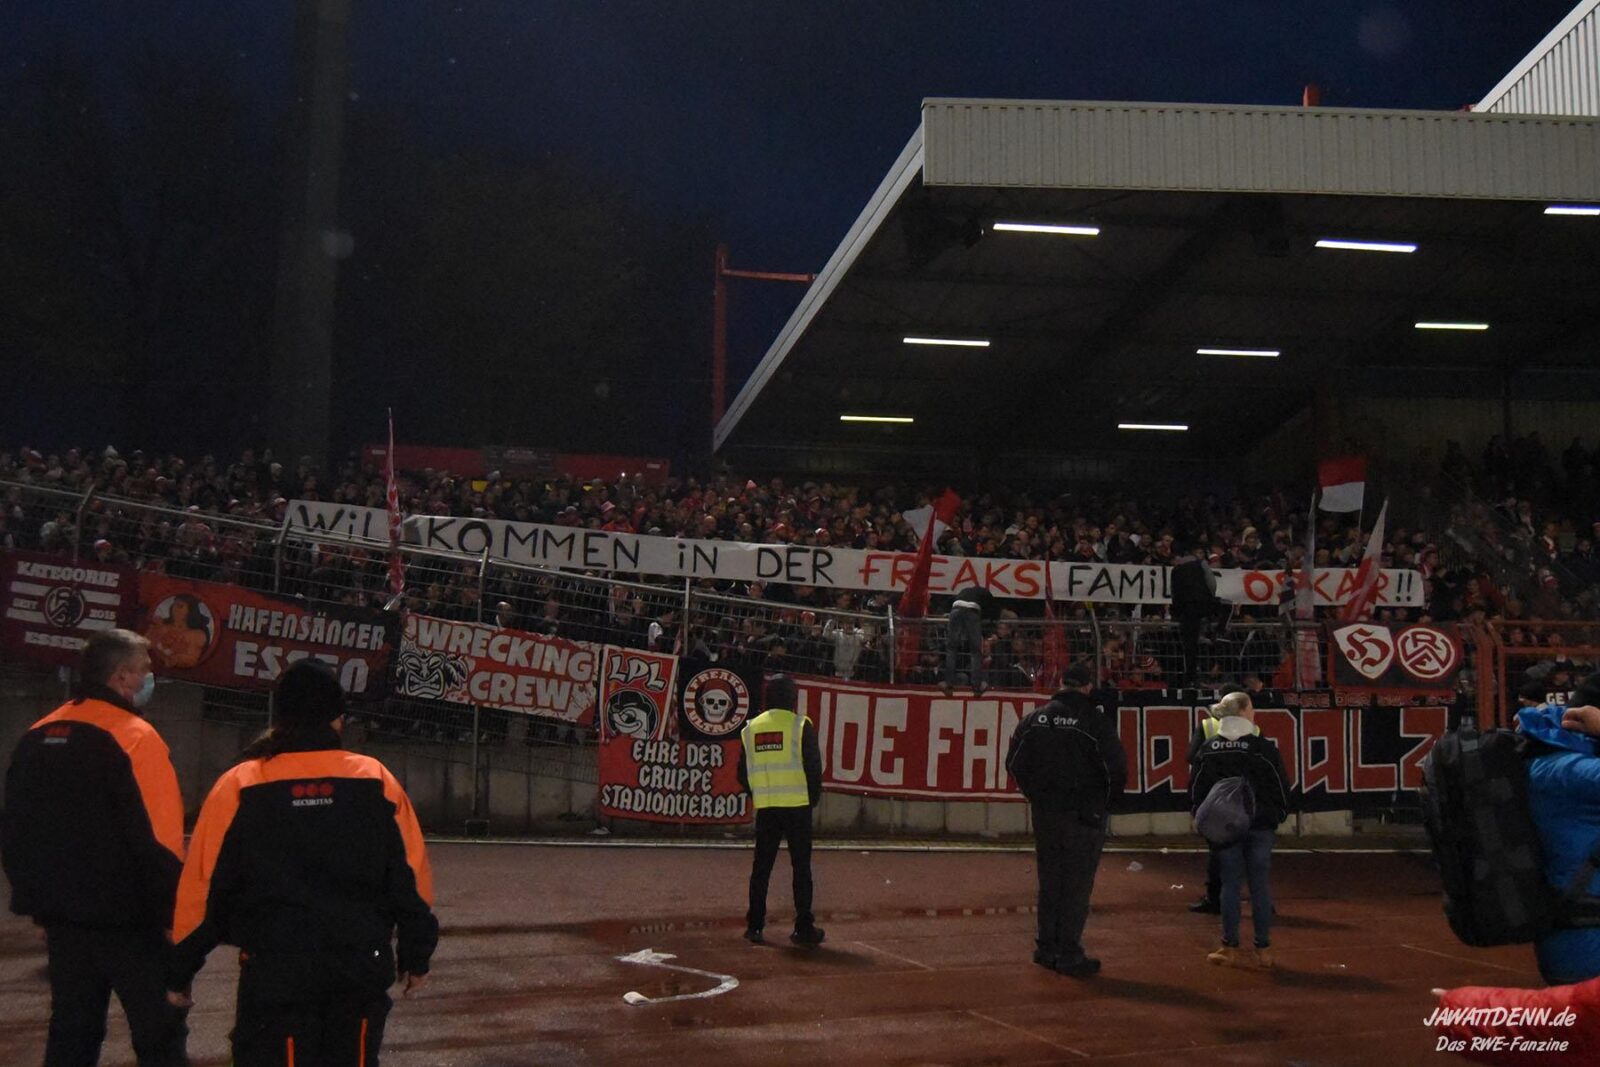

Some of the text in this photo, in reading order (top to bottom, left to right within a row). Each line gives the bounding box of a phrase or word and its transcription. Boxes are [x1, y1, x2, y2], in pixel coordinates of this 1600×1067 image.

[757, 547, 833, 584] DER
[859, 554, 1041, 597] FREAKS
[227, 604, 387, 651] HAFENSÄNGER
[233, 640, 370, 693] ESN
[417, 618, 595, 681] WRECKING
[469, 671, 573, 711] CREW
[609, 655, 666, 691] LDL
[1037, 714, 1079, 726] Odner
[632, 740, 724, 768] EHRE DER
